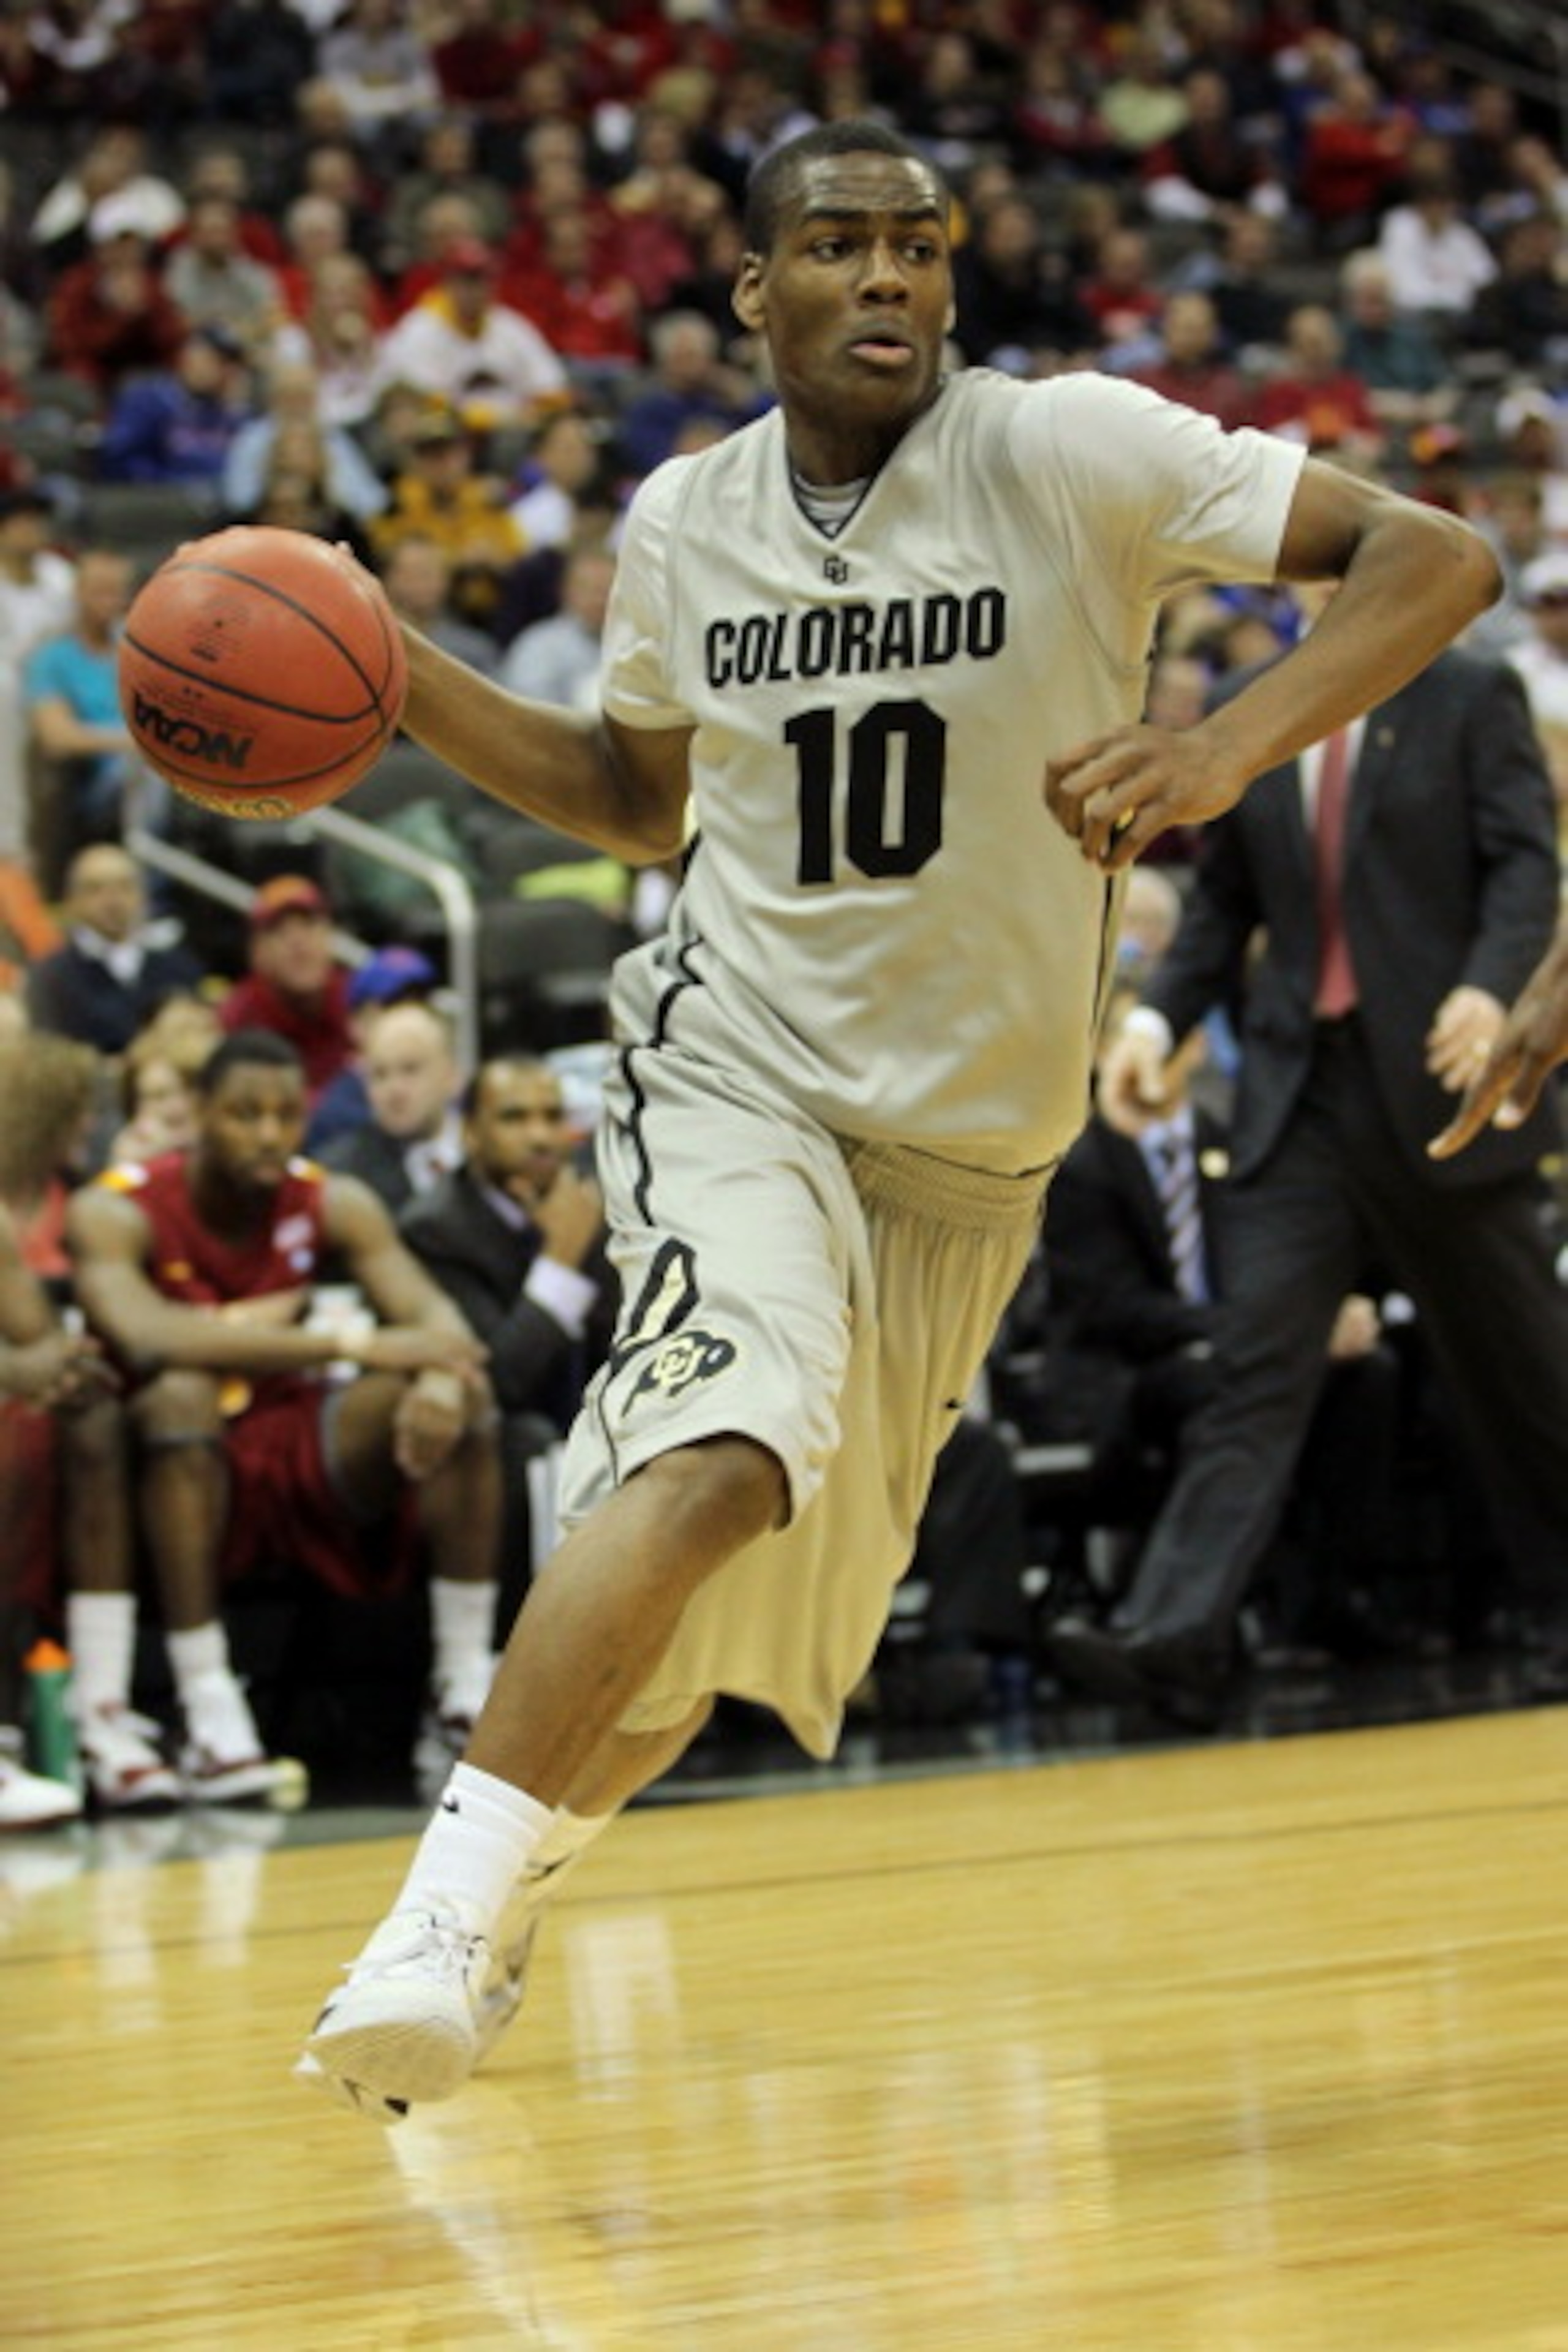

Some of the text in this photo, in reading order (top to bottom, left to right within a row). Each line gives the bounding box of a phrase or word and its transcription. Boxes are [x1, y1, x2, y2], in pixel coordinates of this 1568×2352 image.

[706, 587, 1006, 688] COLORADO
[134, 692, 254, 769] NCAA
[784, 698, 947, 886] 10
